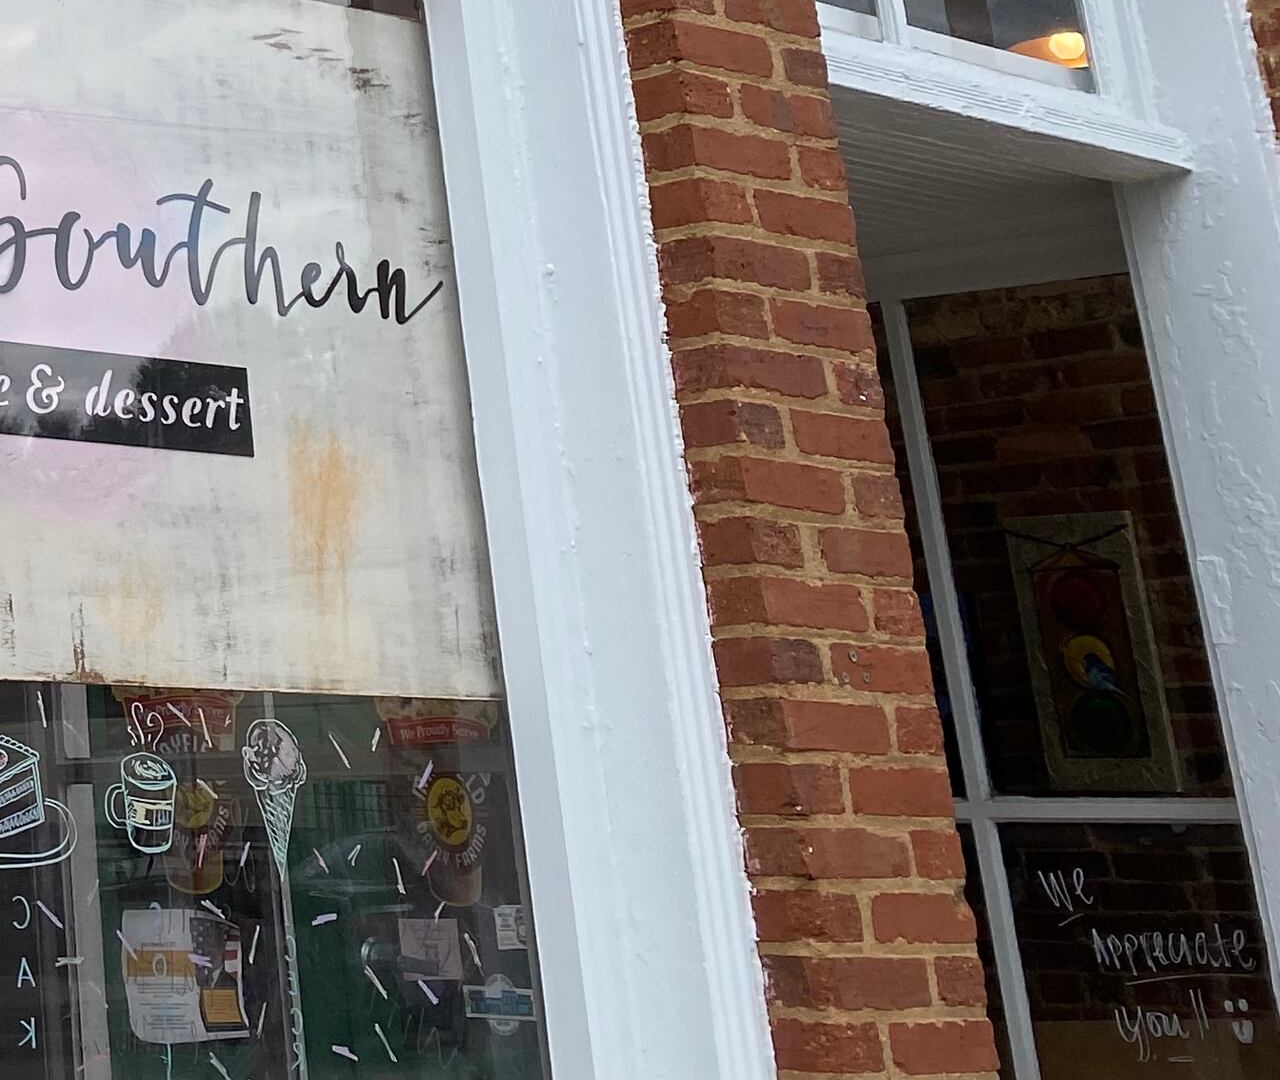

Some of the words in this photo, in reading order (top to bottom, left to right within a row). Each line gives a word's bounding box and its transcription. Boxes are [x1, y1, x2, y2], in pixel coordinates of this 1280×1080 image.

[25, 364, 65, 415] &
[85, 369, 245, 433] dessert
[455, 823, 488, 868] FARMS
[1037, 867, 1094, 912] We
